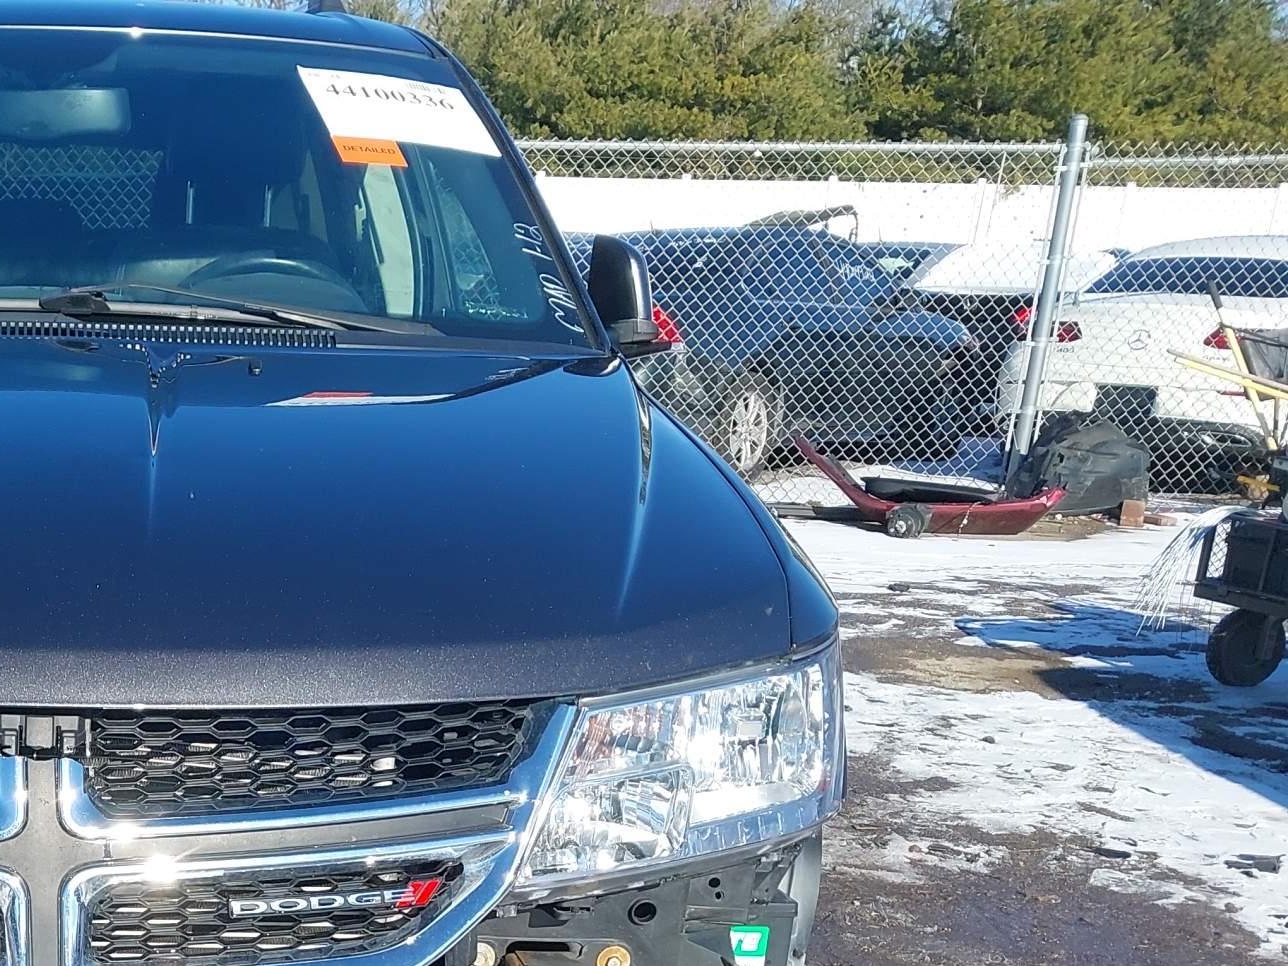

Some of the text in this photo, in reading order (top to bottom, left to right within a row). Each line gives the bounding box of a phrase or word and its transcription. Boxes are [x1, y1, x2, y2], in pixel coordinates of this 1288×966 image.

[326, 83, 455, 110] 44100336
[343, 144, 396, 156] DETAILED
[230, 889, 415, 918] DODGE
